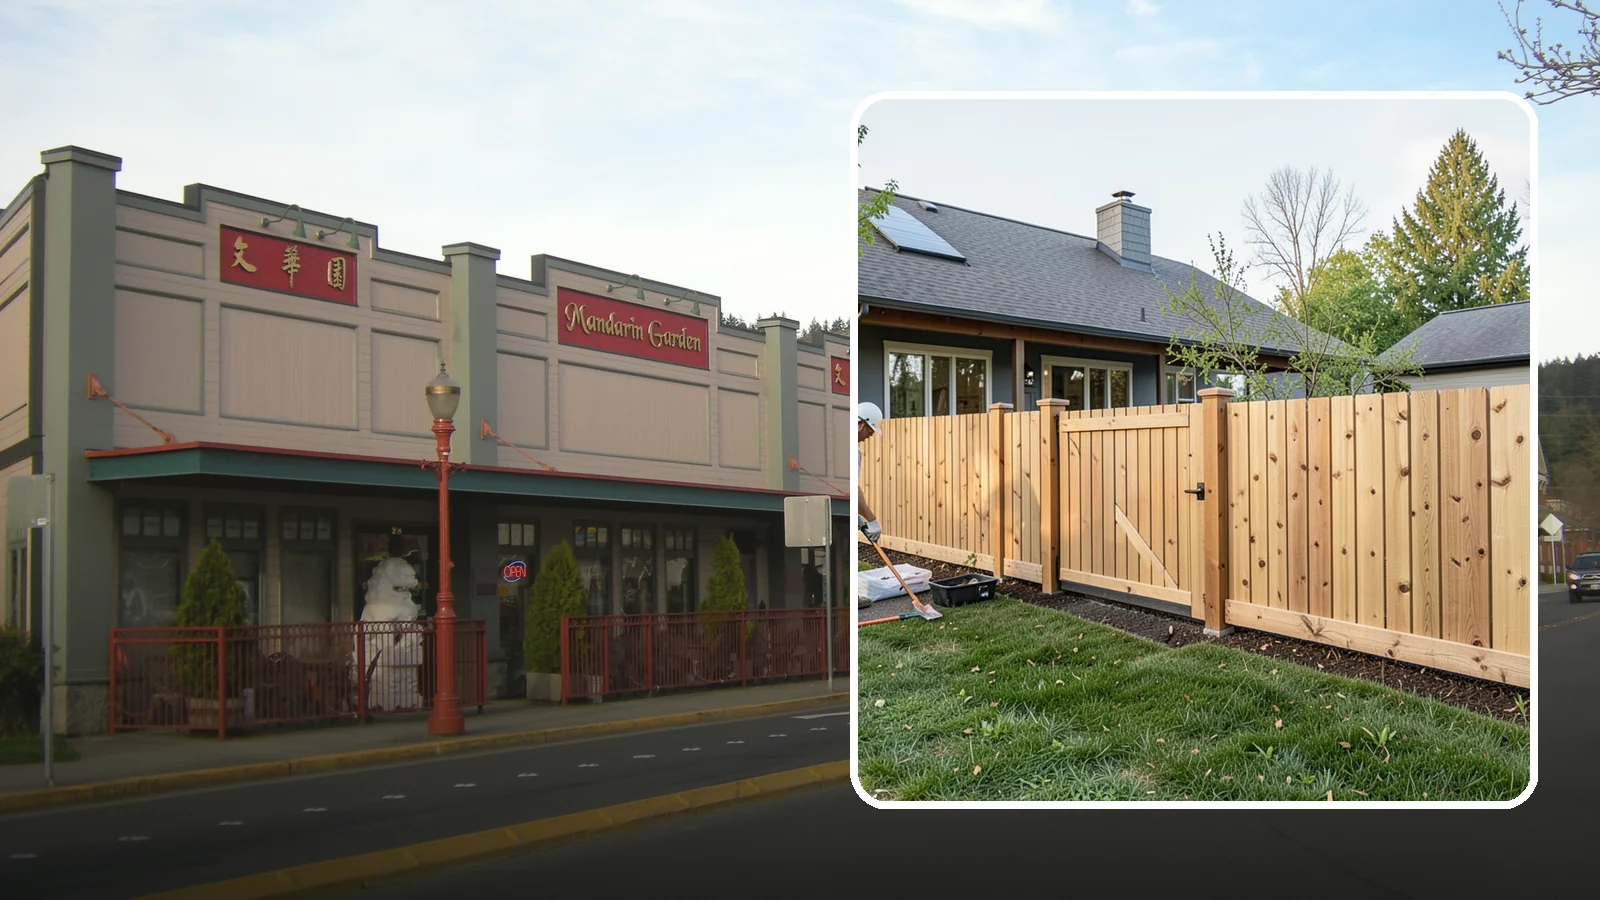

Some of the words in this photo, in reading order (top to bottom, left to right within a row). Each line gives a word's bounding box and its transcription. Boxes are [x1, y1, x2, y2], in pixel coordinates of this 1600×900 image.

[231, 236, 346, 290] 文華園
[564, 302, 643, 341] Mandarin
[648, 320, 701, 352] Garden
[503, 565, 527, 578] OPEN
